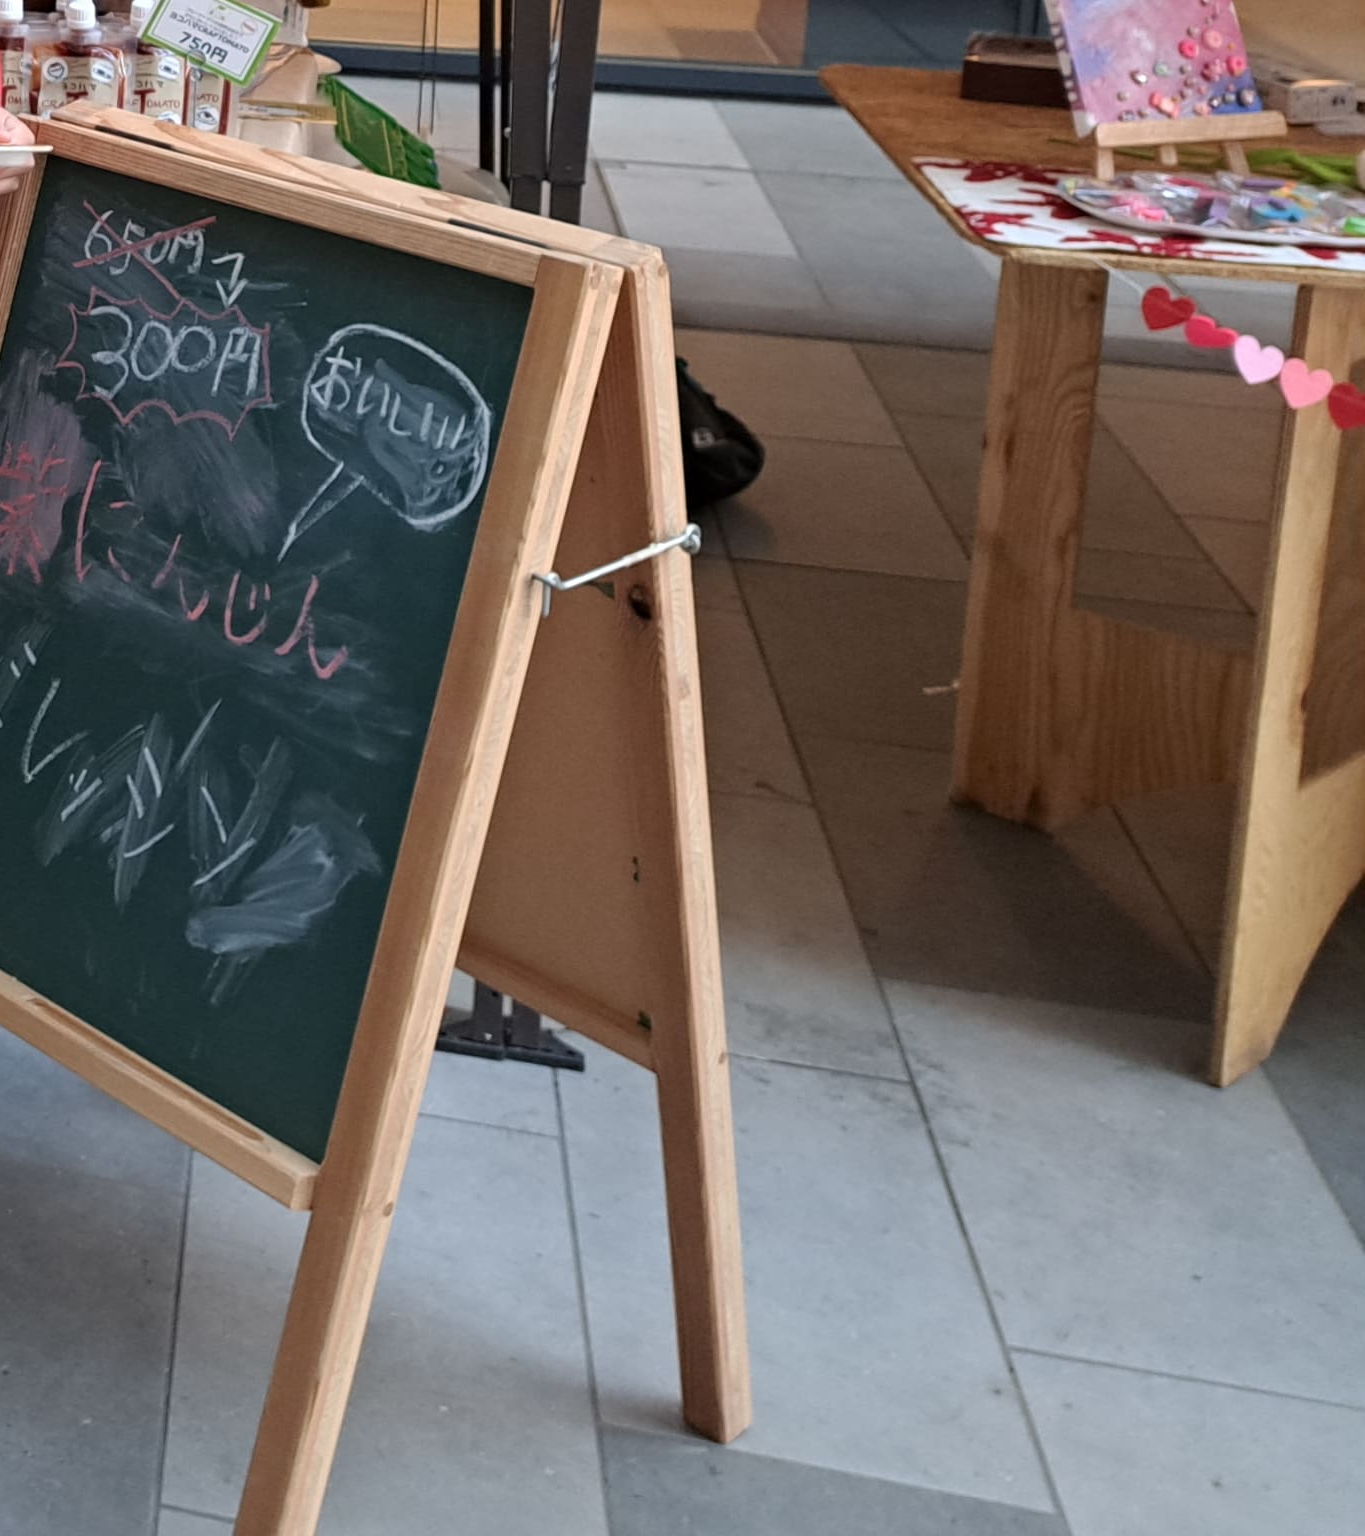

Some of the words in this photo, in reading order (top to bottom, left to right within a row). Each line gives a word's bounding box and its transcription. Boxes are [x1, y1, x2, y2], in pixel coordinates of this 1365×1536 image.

[179, 31, 228, 64] 750円
[84, 209, 205, 276] 650円
[89, 305, 262, 400] 300円
